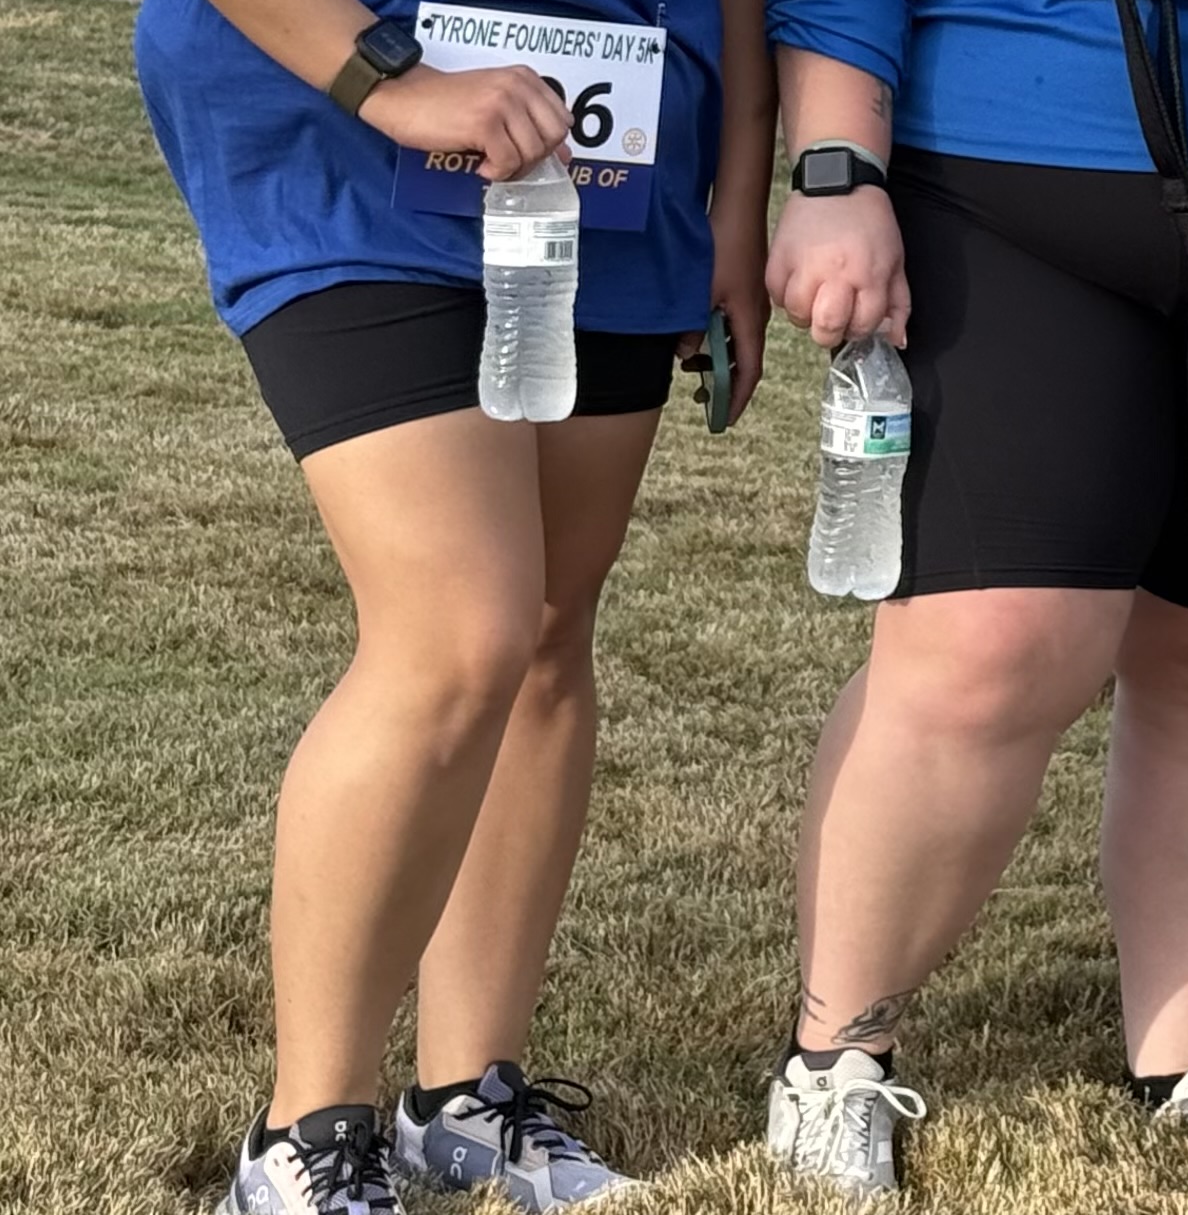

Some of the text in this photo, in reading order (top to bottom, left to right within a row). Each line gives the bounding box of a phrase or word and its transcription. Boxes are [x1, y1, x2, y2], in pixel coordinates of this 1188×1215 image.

[429, 13, 502, 48] TYRONE
[602, 32, 636, 62] DAY
[636, 35, 658, 64] 5K
[597, 167, 629, 188] OF
